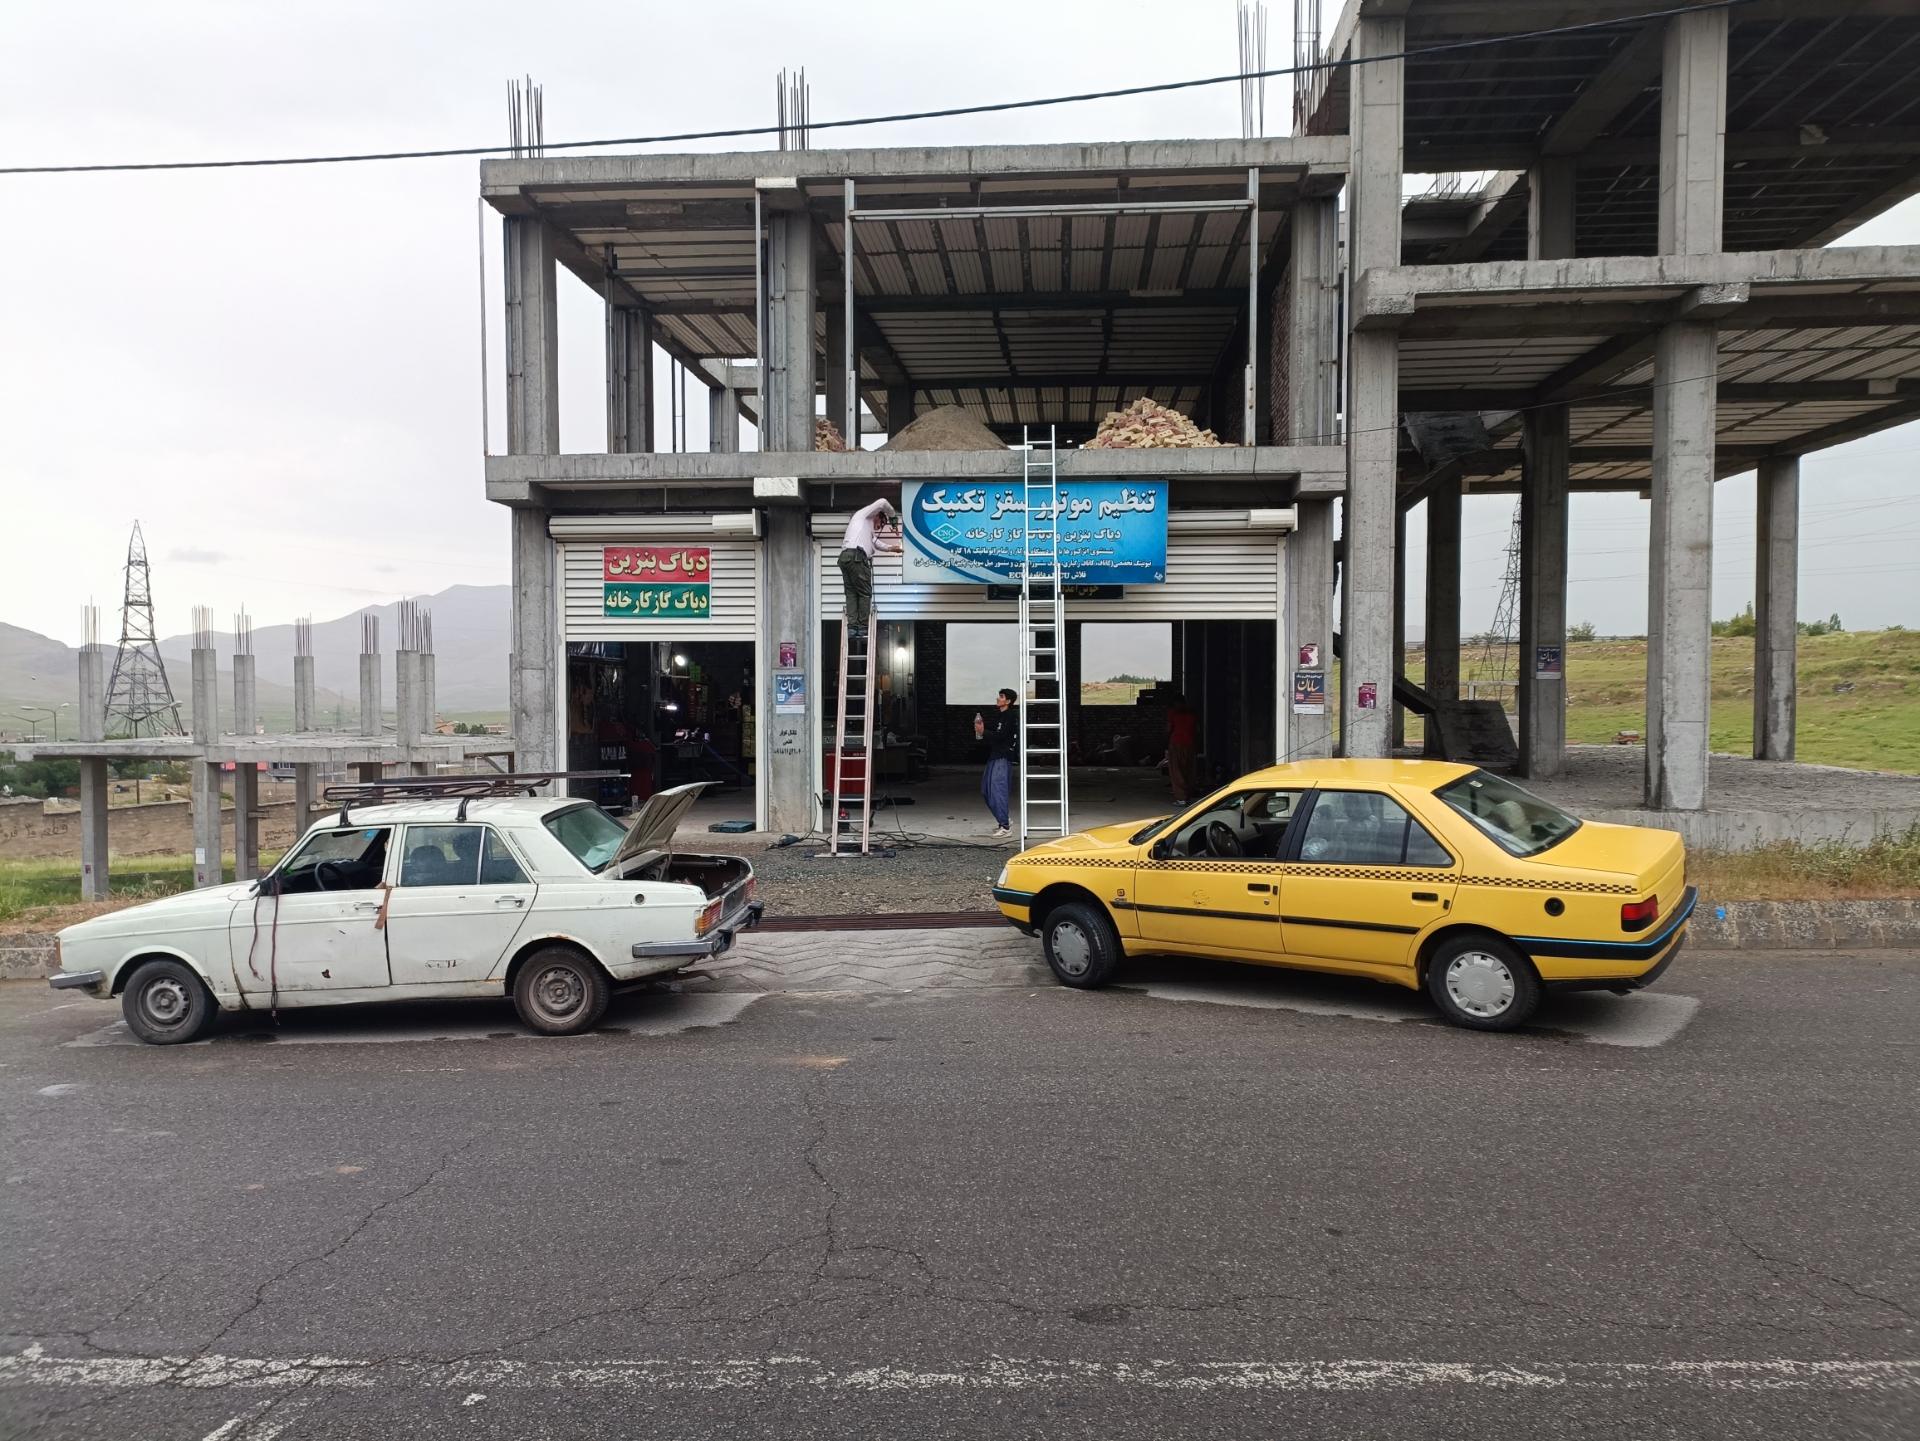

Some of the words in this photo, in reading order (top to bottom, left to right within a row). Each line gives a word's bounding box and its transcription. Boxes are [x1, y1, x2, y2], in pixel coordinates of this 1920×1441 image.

[921, 489, 986, 518] تکنیک
[990, 490, 1028, 520] سقز
[1034, 490, 1092, 520] موتور
[1098, 488, 1156, 519] تنظیم
[965, 528, 1004, 541] کارخانه
[1055, 533, 1061, 543] و
[1064, 529, 1091, 542] بنزین
[608, 551, 657, 575] بنزین
[606, 590, 653, 614] کارخانه
